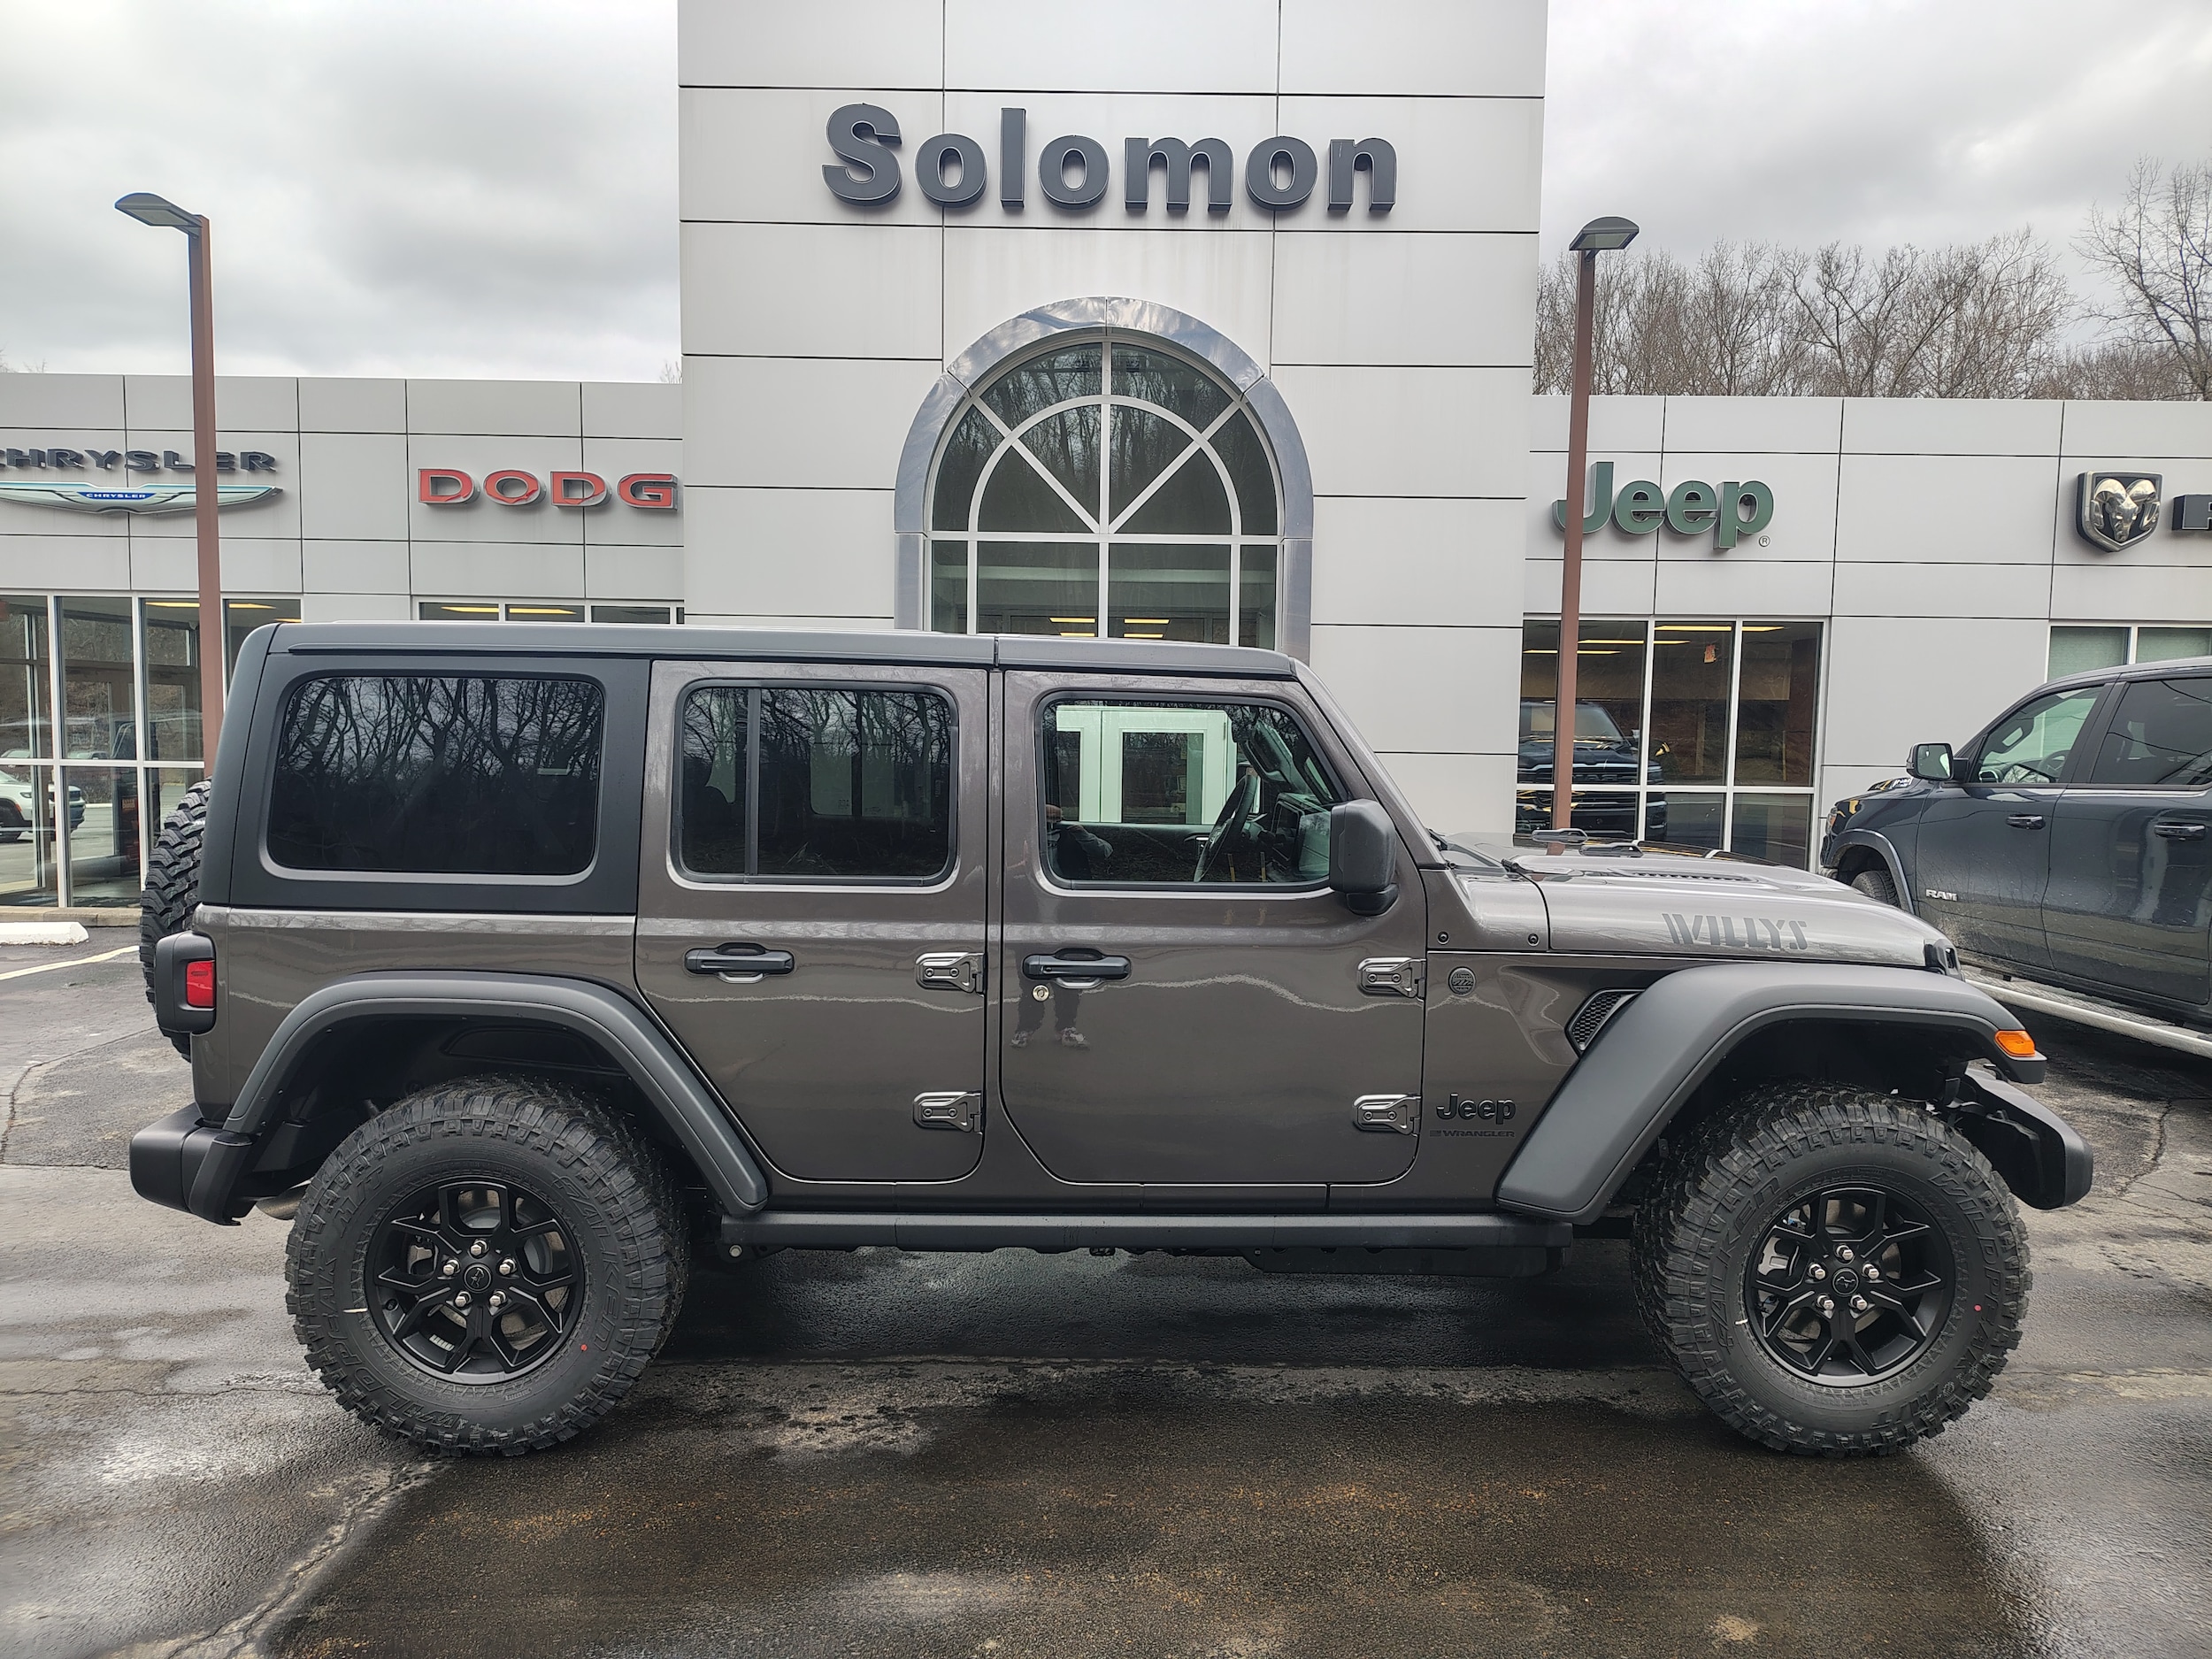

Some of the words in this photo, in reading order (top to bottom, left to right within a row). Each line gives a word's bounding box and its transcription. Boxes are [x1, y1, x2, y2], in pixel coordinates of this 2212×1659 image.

[821, 103, 1399, 212] Solomon
[0, 448, 276, 472] HRYSLER
[1552, 461, 1774, 550] Jeep
[1925, 888, 1958, 902] RAM
[1662, 913, 1808, 950] WILLYS
[1436, 1093, 1517, 1125] Jeep
[1442, 1129, 1516, 1139] WRANGLER
